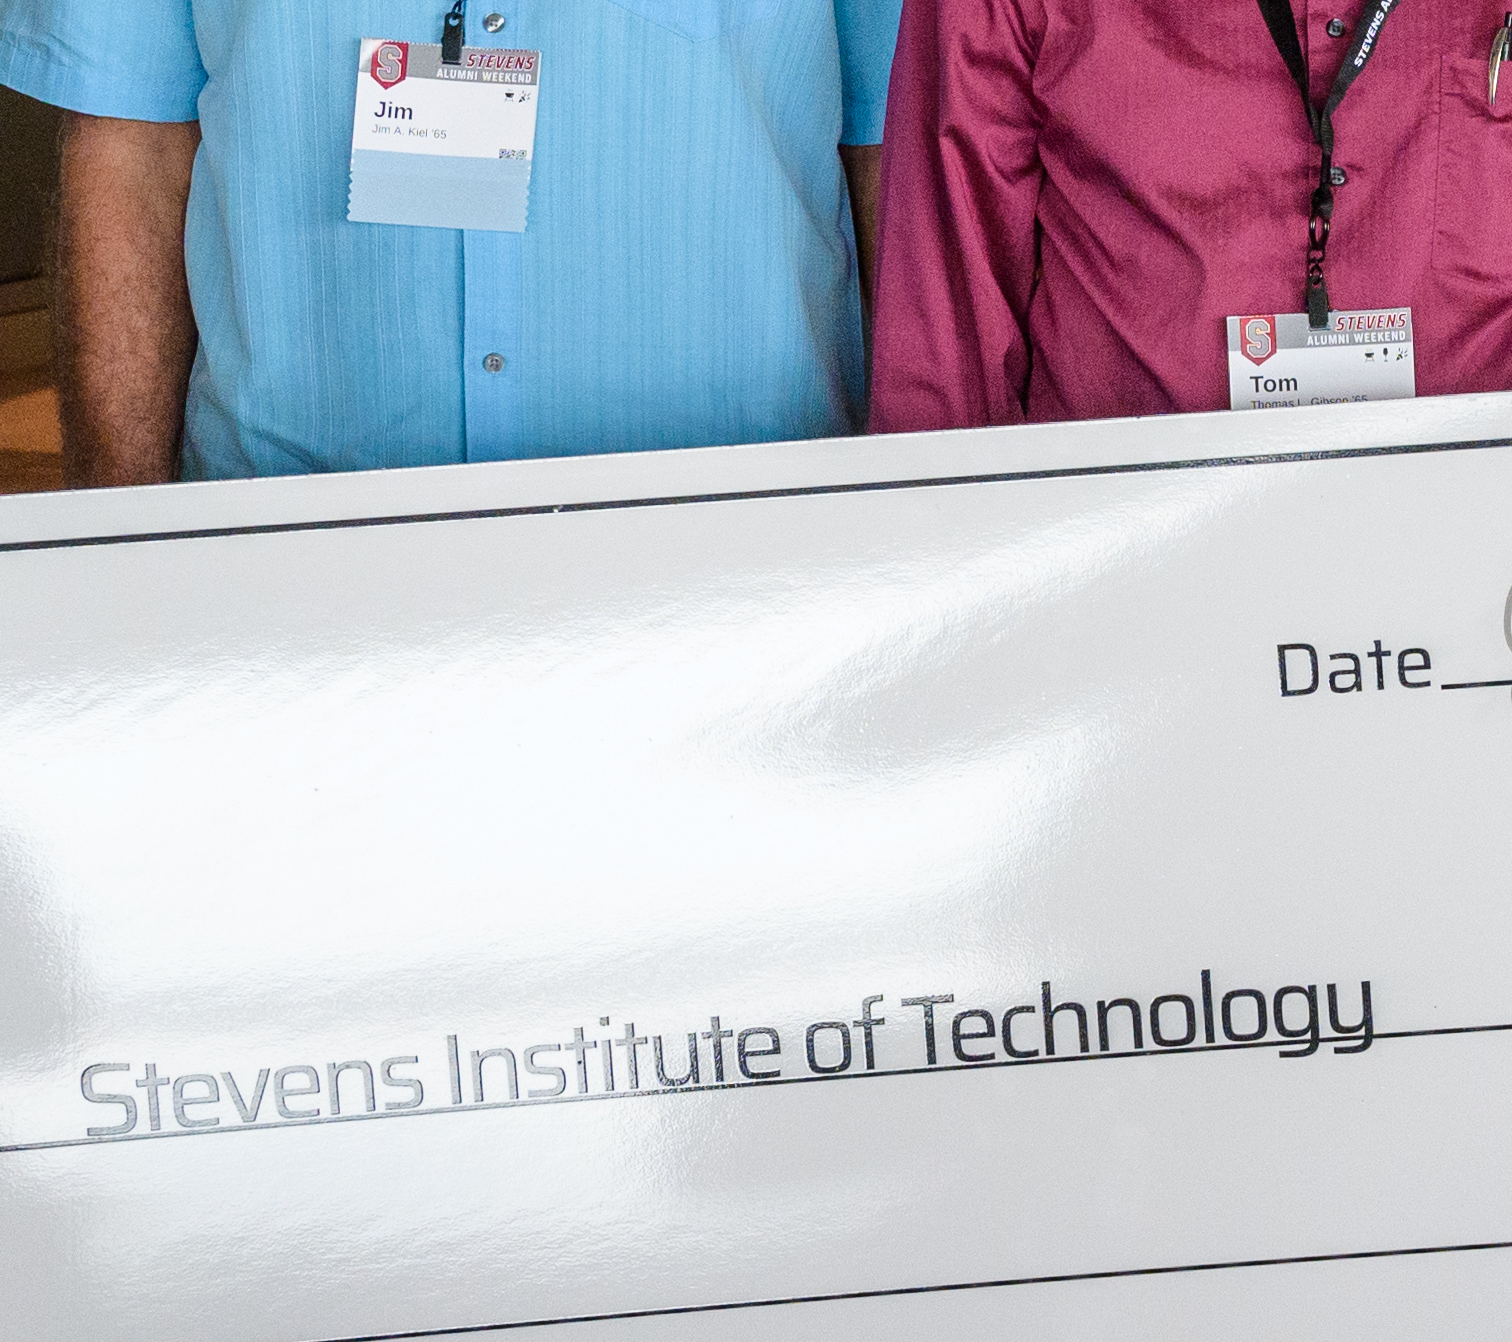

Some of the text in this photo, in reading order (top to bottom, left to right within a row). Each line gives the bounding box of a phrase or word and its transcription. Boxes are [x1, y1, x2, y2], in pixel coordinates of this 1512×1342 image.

[1354, 10, 1385, 68] STEVENS
[376, 43, 536, 83] S STEVENS
[436, 67, 533, 85] ALUMNI WEEKEND
[373, 100, 414, 121] Jim
[372, 124, 448, 140] Jim A. Kiel '65
[1245, 312, 1407, 359] S STEVENS
[1307, 330, 1406, 347] ALUMNI WEEKEND
[1250, 375, 1299, 394] Tom
[1276, 639, 1434, 698] Date
[80, 1054, 425, 1139] Stevens
[446, 1011, 783, 1107] Institute
[802, 993, 883, 1075] of
[900, 969, 1375, 1058] Technology
